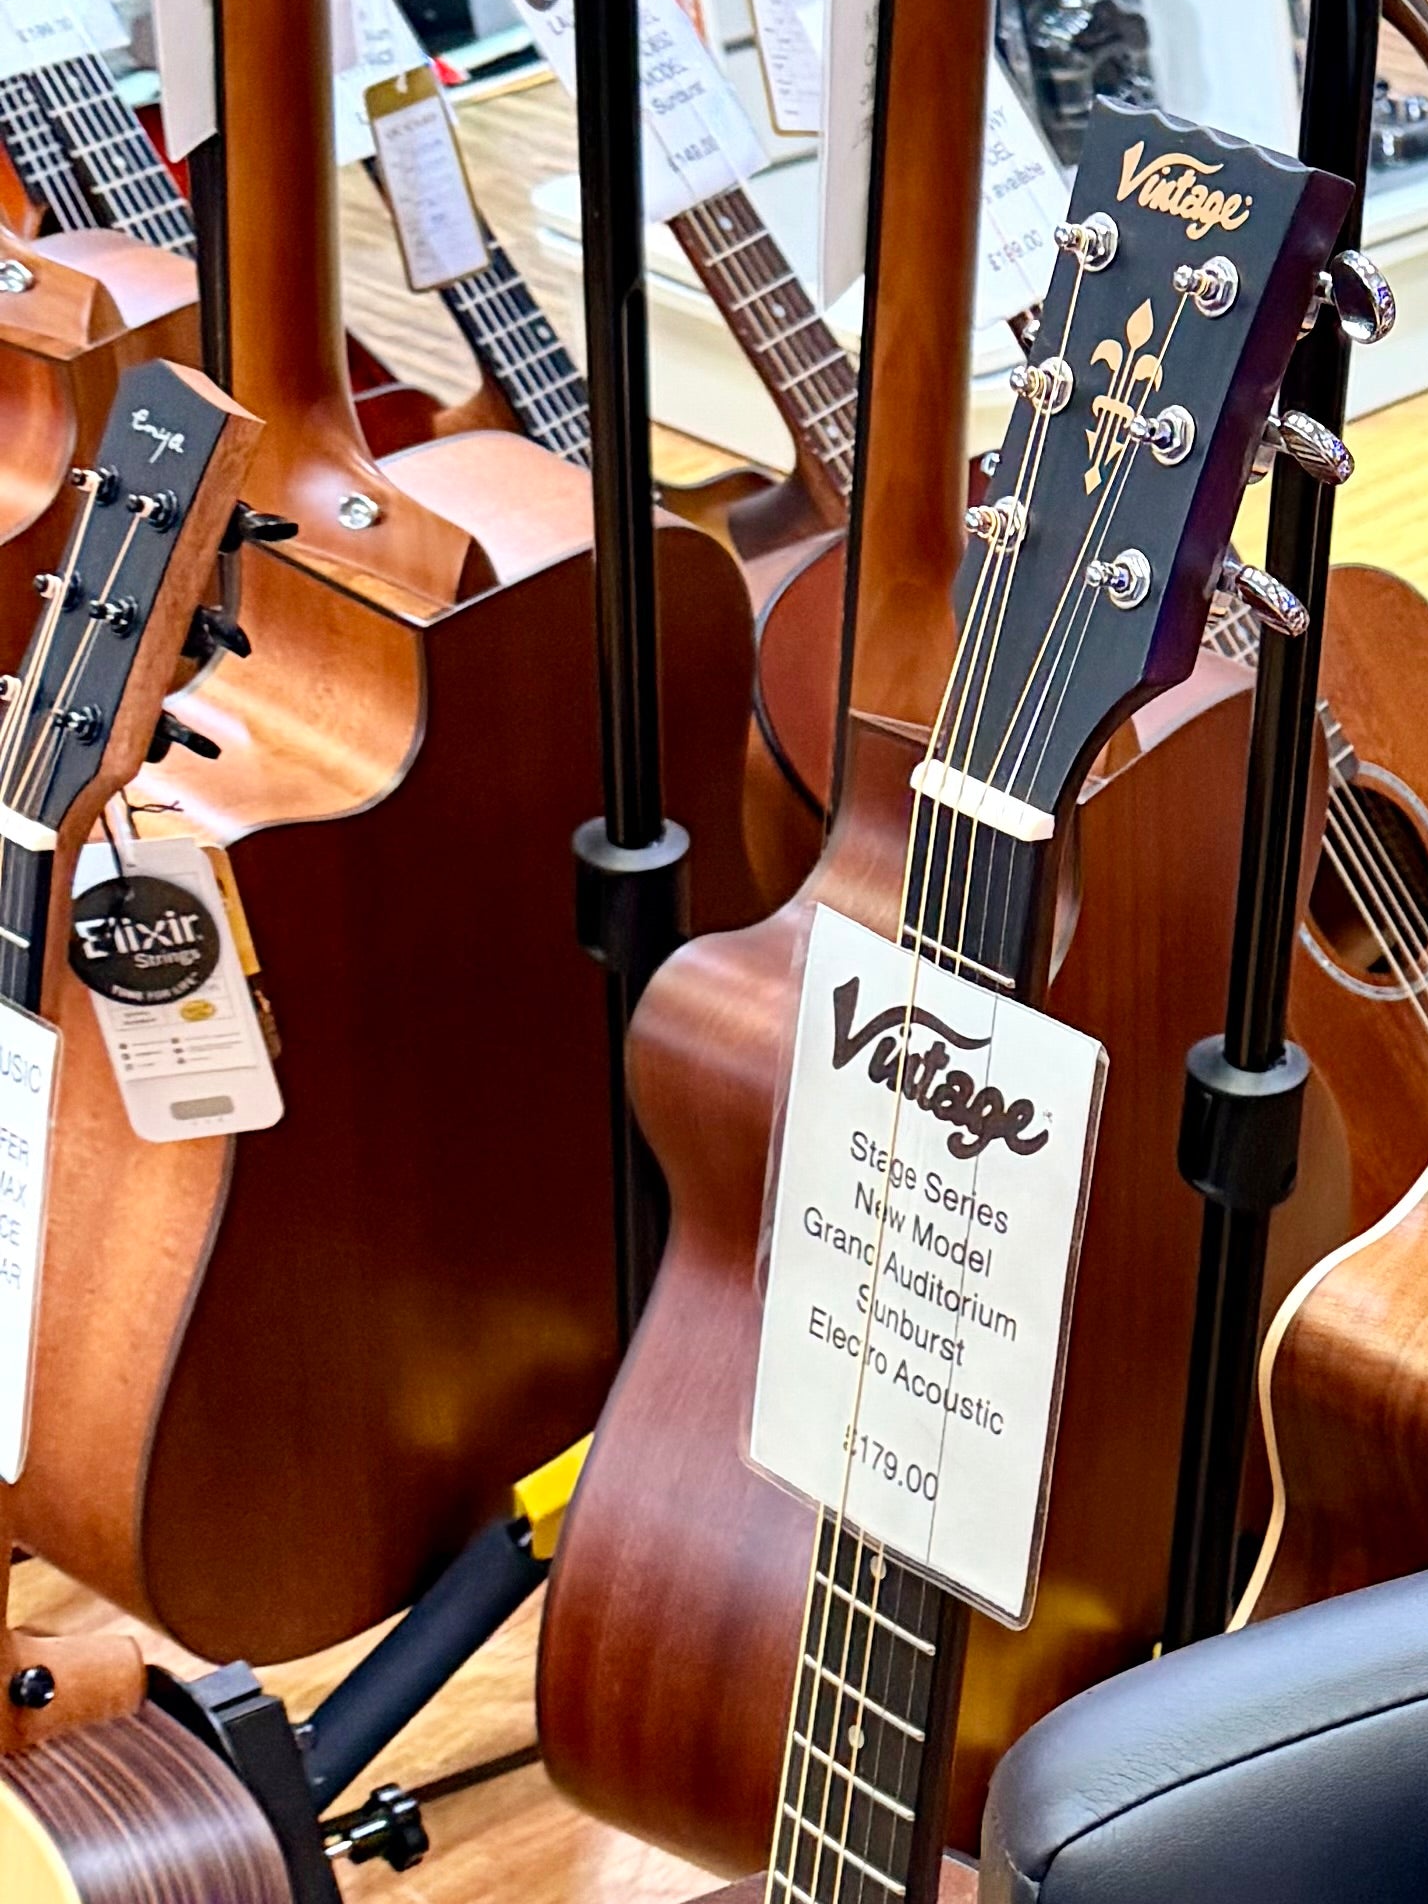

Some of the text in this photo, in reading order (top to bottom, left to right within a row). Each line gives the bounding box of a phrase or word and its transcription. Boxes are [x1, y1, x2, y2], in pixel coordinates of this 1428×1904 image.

[1114, 139, 1252, 241] Vintage
[74, 910, 200, 960] Elixir
[133, 948, 202, 970] Strings
[0, 1051, 43, 1094] USIC
[830, 976, 1050, 1161] Vintage
[849, 1130, 1011, 1235] Stage Series
[802, 1206, 1019, 1342] Grand Auditorium
[854, 1182, 994, 1278] New Model
[856, 1282, 966, 1368] Sunburst
[892, 1357, 1006, 1437] Acoustic
